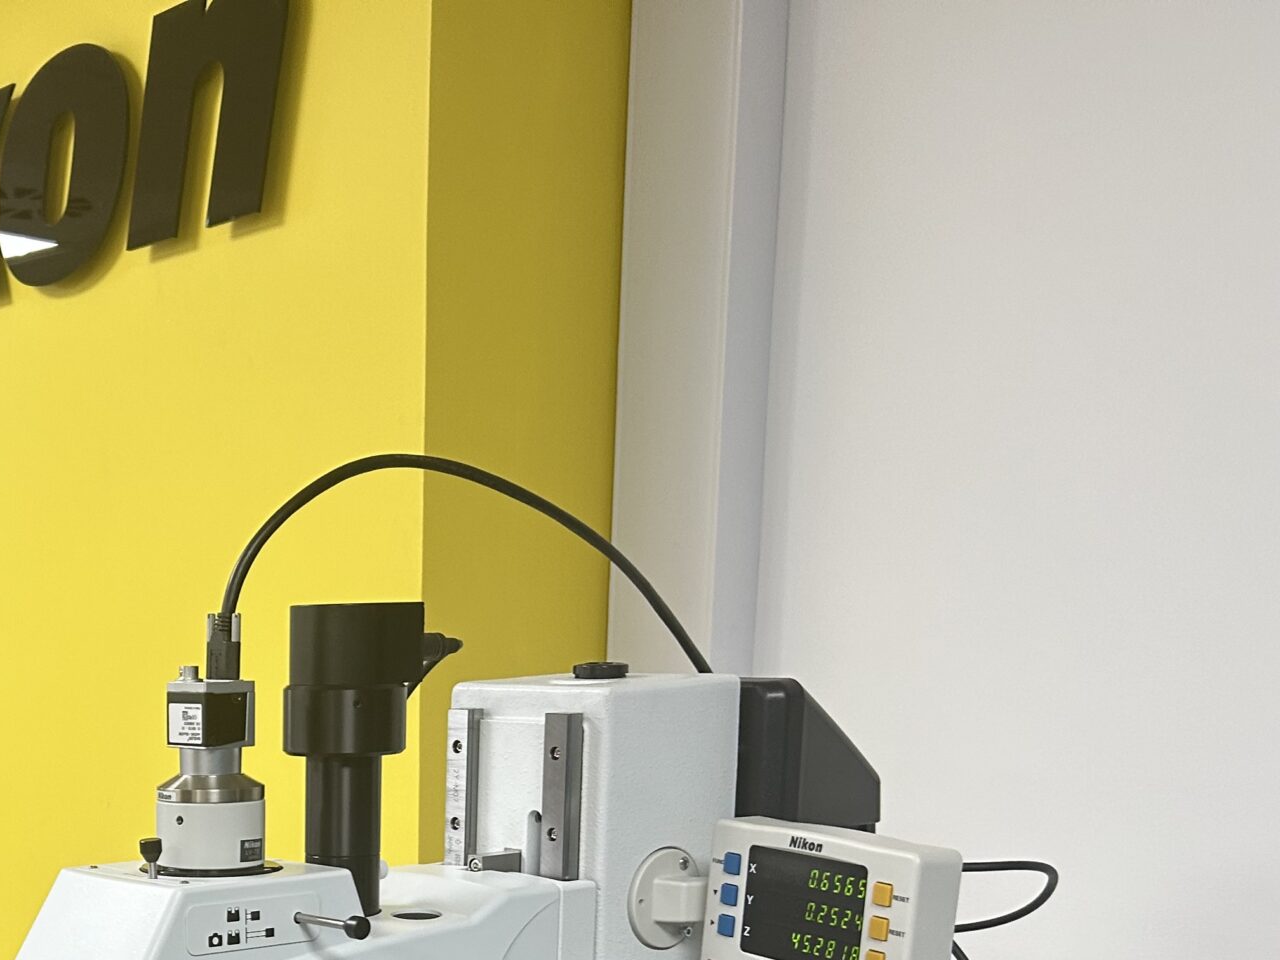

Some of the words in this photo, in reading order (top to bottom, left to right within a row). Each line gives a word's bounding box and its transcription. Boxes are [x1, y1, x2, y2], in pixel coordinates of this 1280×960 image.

[789, 836, 823, 853] Nikon
[749, 863, 757, 874] X
[808, 869, 866, 899] 0.6565
[893, 894, 910, 903] RESET
[746, 894, 754, 905] Y
[805, 902, 862, 931] 0.2524
[743, 926, 751, 936] Z
[889, 929, 905, 938] RESET
